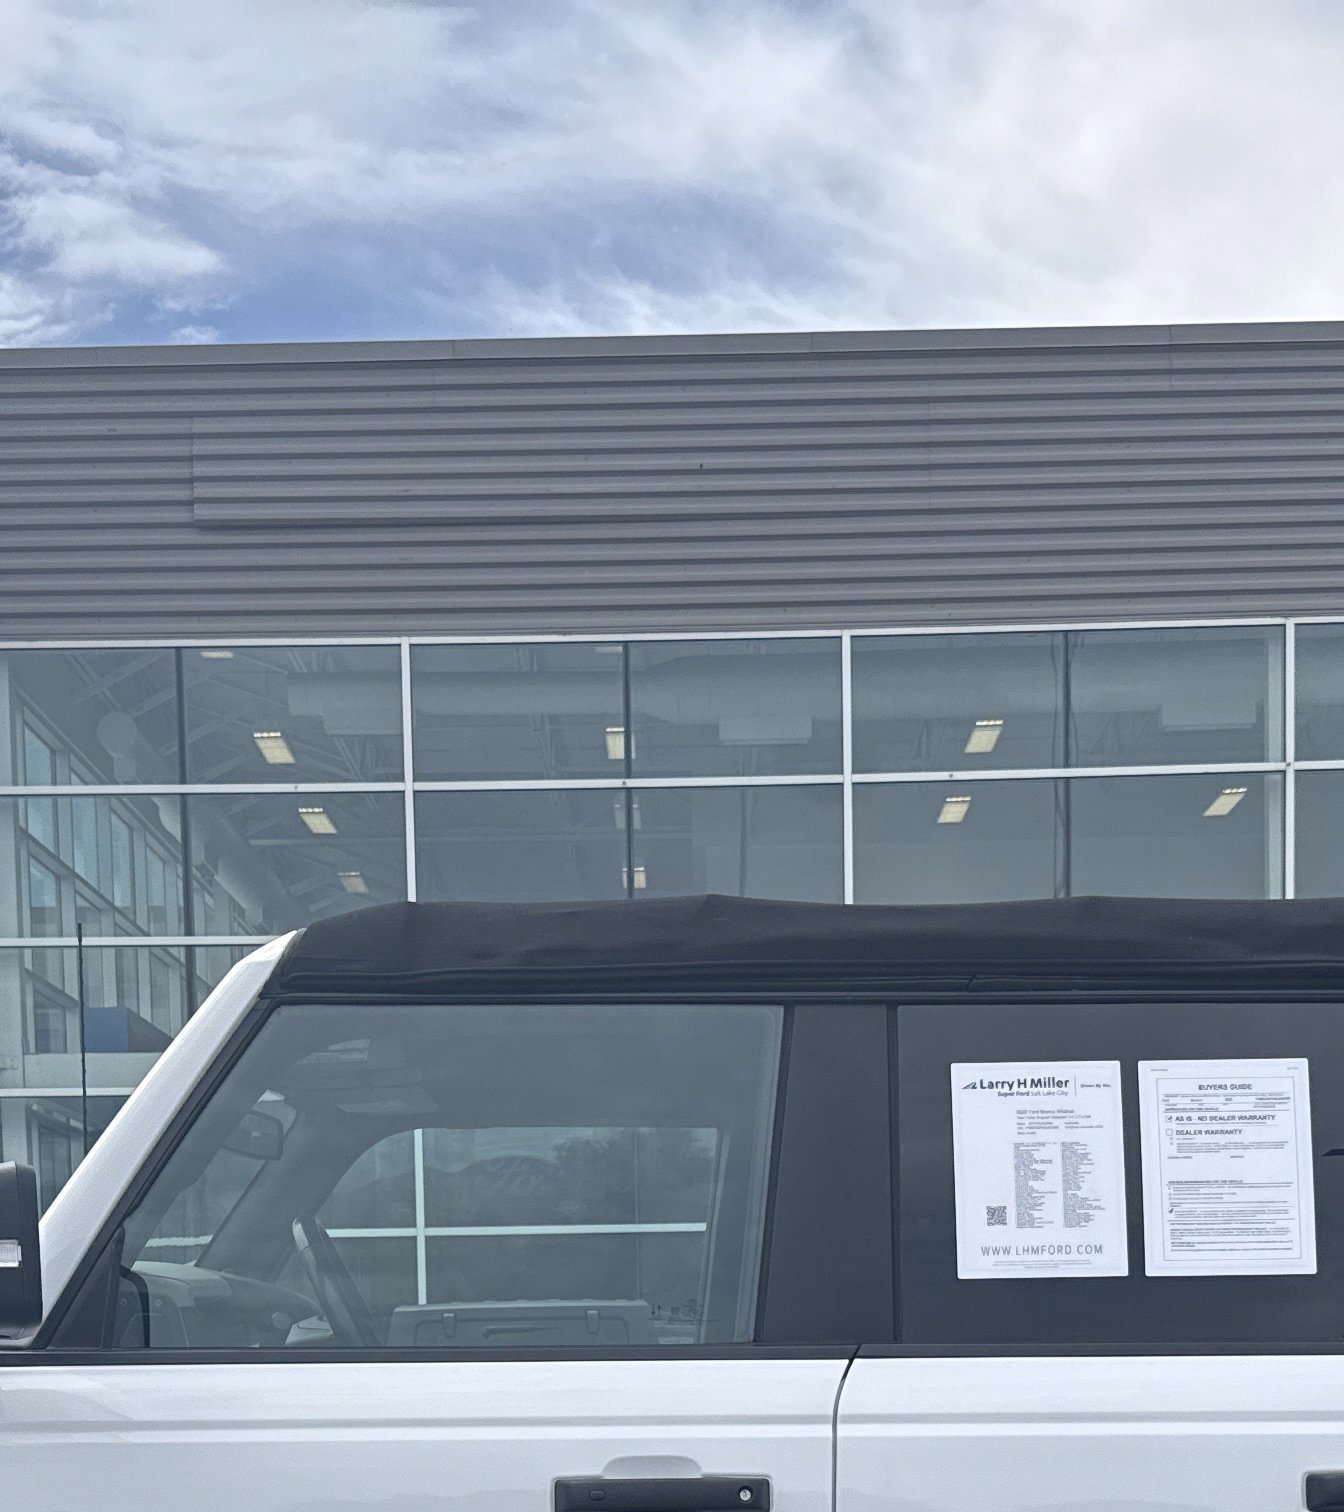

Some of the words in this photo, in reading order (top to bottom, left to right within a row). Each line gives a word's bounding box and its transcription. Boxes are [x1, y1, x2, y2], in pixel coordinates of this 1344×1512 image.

[979, 1078, 1015, 1091] Larry
[1017, 1078, 1028, 1089] H
[1030, 1076, 1070, 1089] Miller
[1204, 1128, 1243, 1136] WARRANTY
